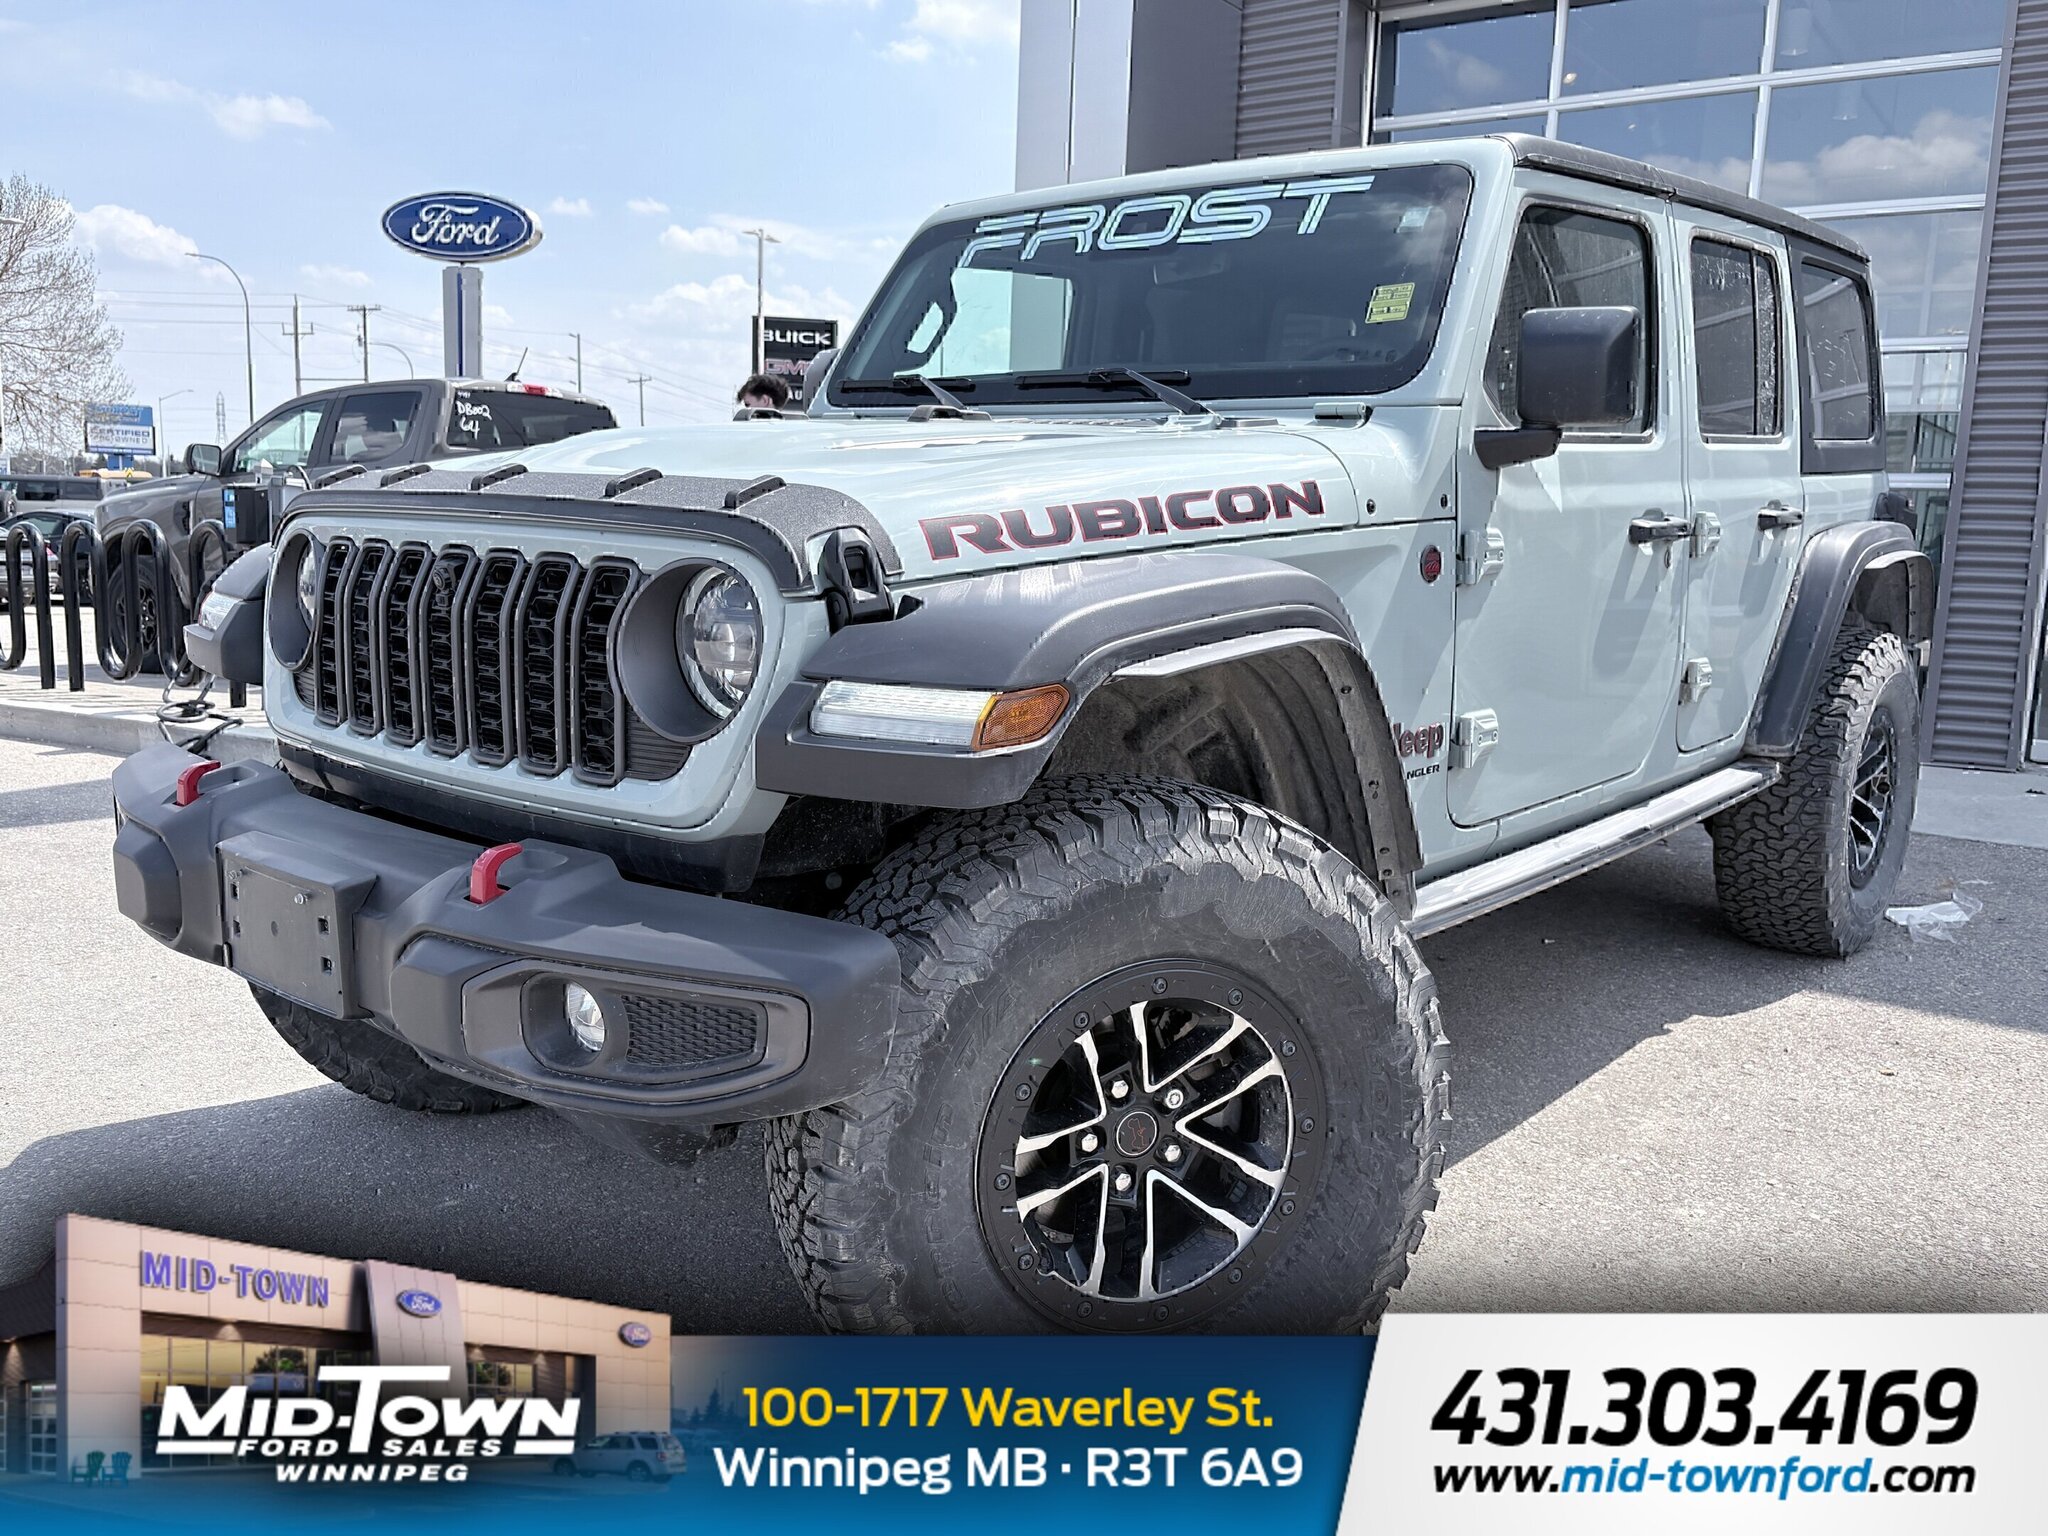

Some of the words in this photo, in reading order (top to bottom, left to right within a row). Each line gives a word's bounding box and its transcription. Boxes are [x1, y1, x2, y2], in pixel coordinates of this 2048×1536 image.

[411, 203, 502, 246] Ford
[957, 175, 1376, 268] FROST
[763, 329, 832, 345] BUICK
[765, 358, 814, 376] GM
[90, 427, 150, 438] CERTIFIED
[918, 480, 1325, 561] RUBICON
[1406, 764, 1440, 780] NGLER
